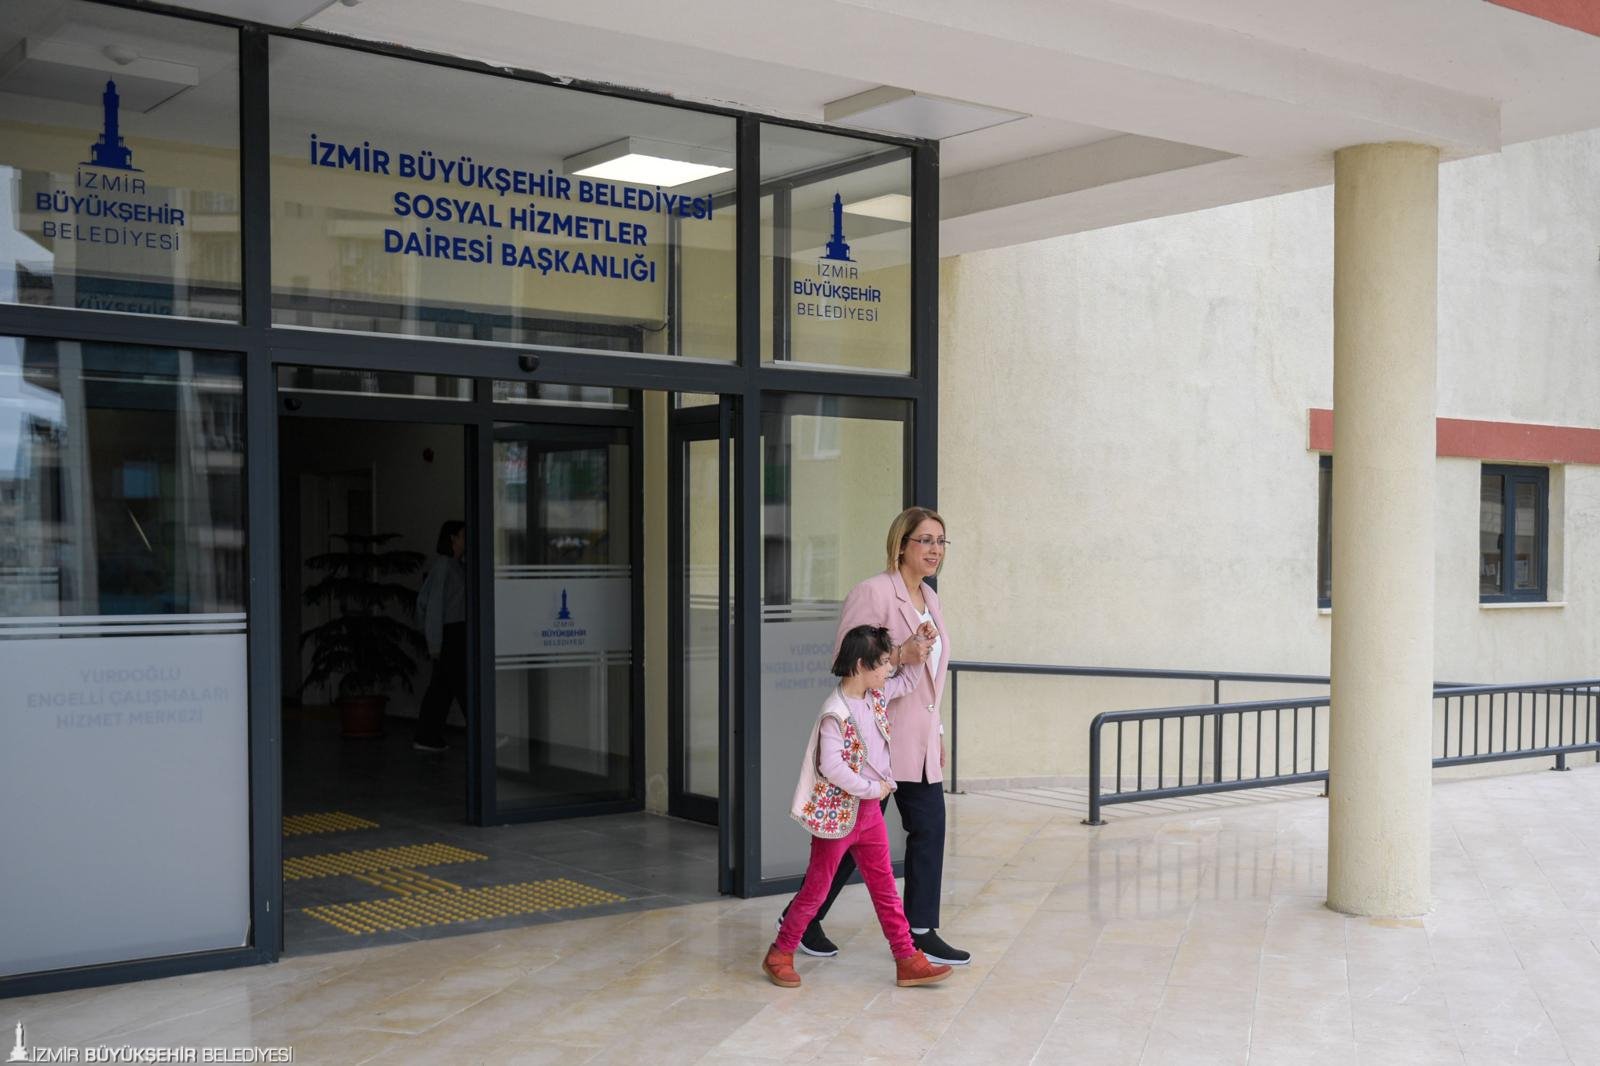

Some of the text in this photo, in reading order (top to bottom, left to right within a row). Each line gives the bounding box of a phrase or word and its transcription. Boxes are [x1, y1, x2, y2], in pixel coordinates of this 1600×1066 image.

[76, 167, 146, 194] İZMİR
[310, 133, 713, 221] İZMİR BÜYÜKŞEHİR BELEDİYESİ
[36, 190, 185, 226] BÜYÜKŞEHİR
[393, 192, 648, 246] SOSYAL HİZMETLER
[42, 220, 180, 251] BELEDİYESİ
[384, 227, 656, 283] DAİRESİ BAŞKANLIĞI
[817, 261, 858, 280] İZMİR
[793, 278, 881, 303] BÜYÜKŞEHİR
[797, 302, 878, 322] BELEDİYESİ
